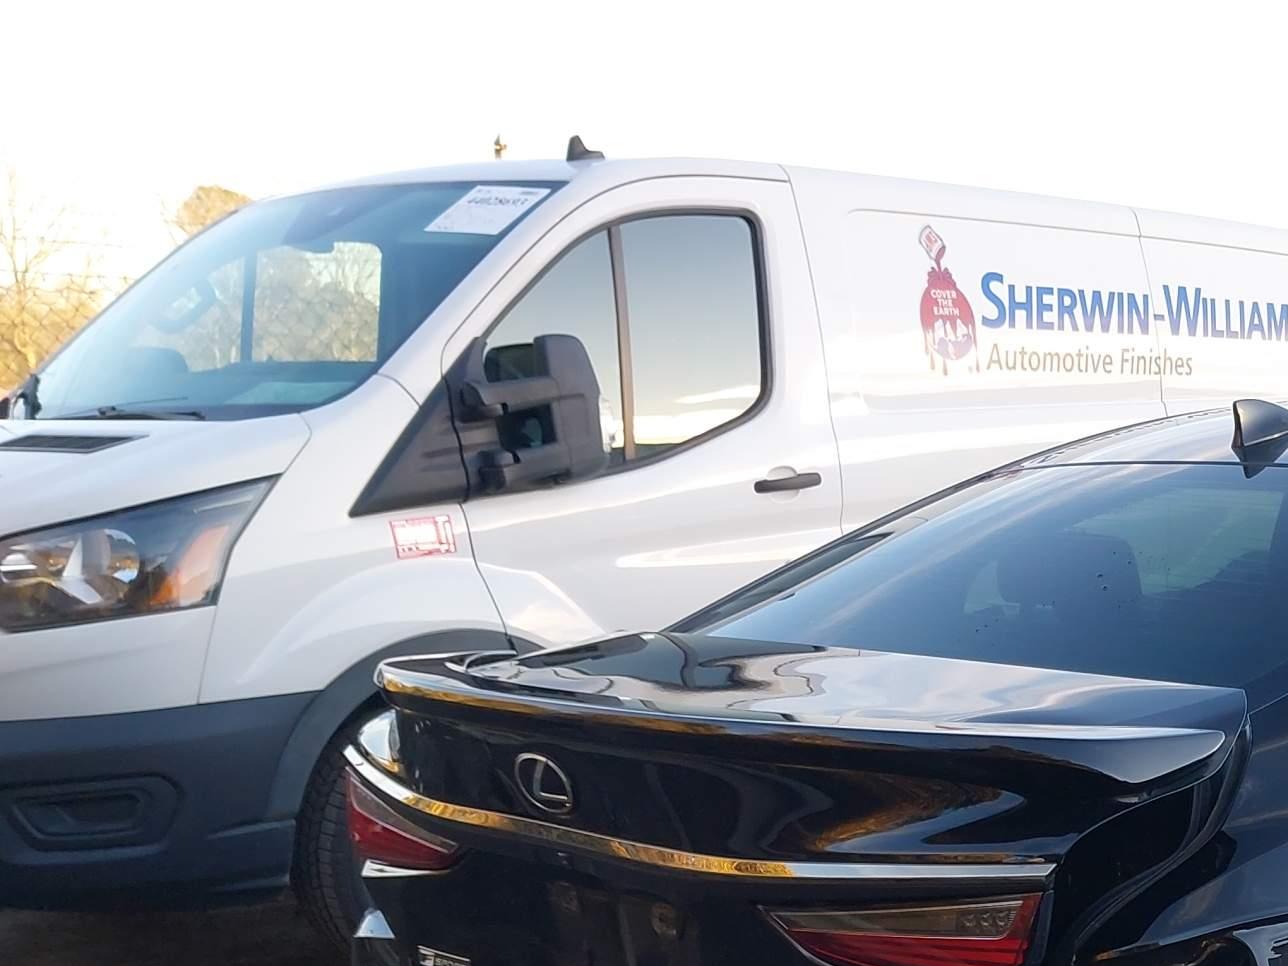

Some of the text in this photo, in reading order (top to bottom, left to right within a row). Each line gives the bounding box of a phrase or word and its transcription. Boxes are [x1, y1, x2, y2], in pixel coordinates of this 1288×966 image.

[930, 289, 957, 299] COVER
[937, 299, 952, 307] THE
[933, 306, 960, 316] EARTH
[986, 343, 1193, 376] Automotive Finishes
